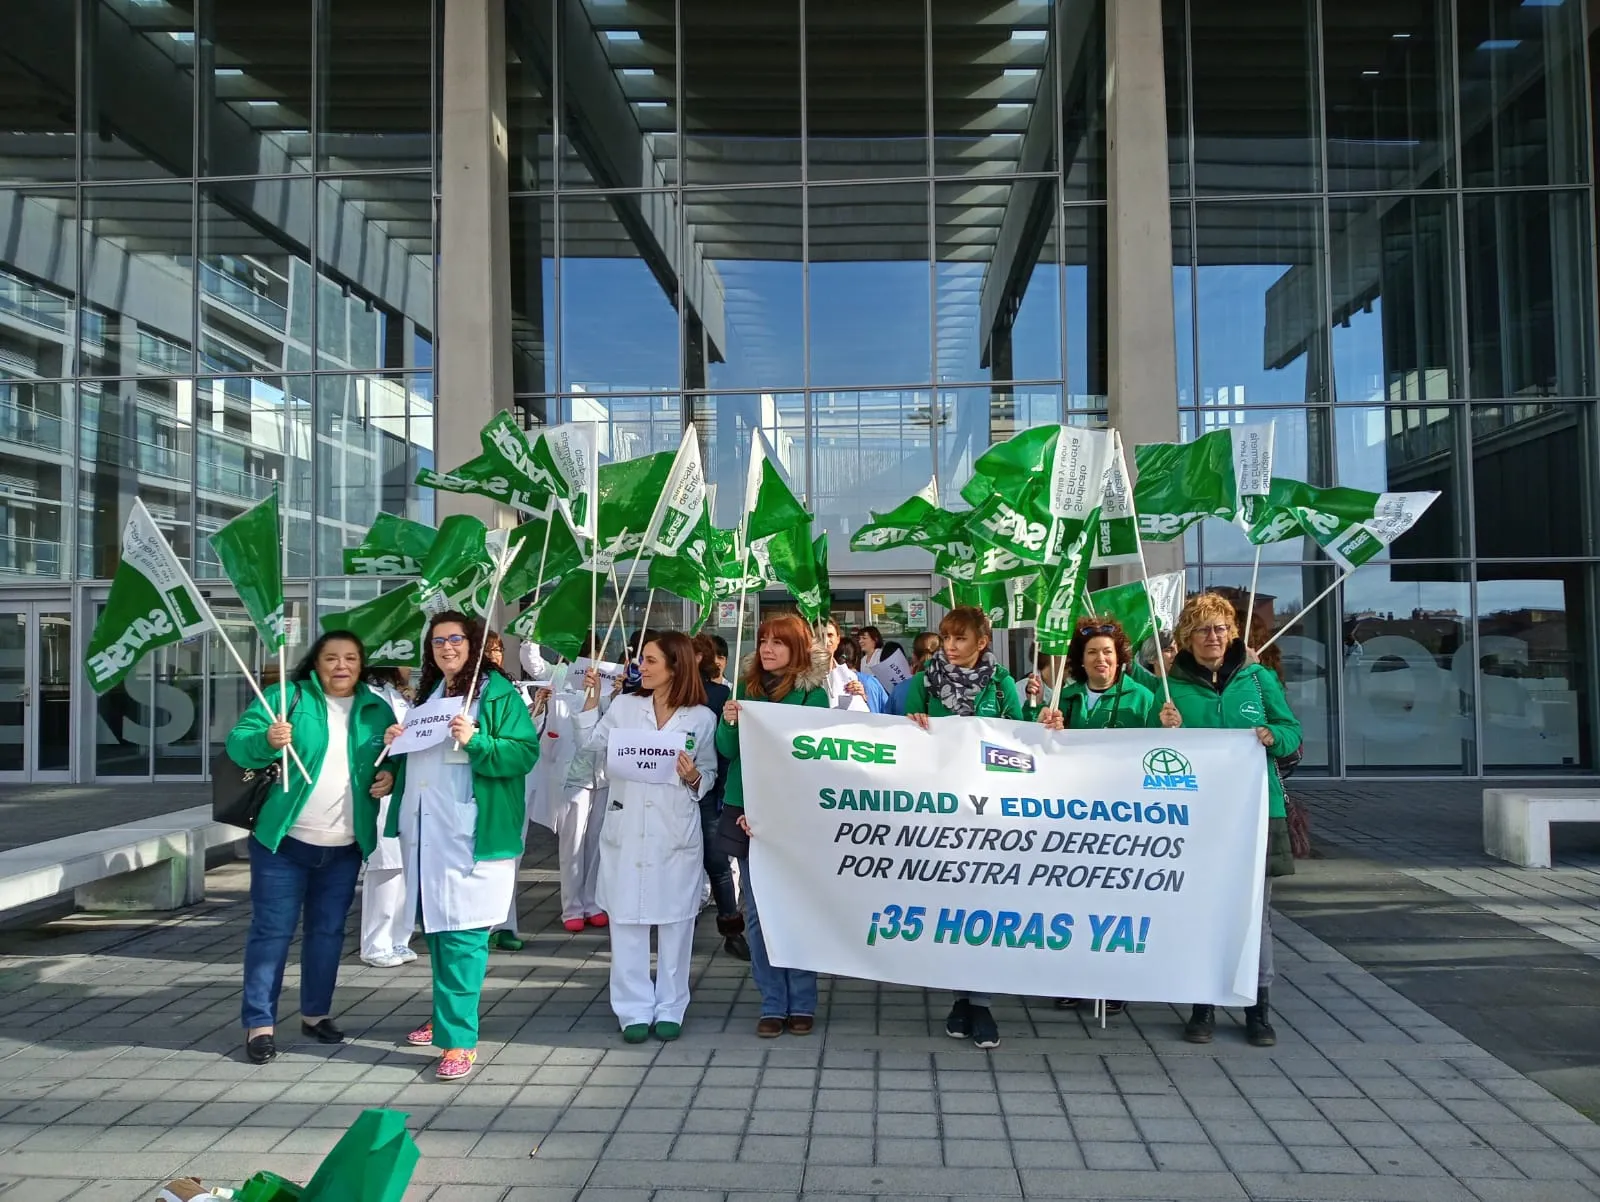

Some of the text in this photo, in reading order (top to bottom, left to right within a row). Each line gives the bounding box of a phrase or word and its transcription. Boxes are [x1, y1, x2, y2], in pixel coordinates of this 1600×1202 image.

[351, 555, 421, 575] TSE
[420, 714, 451, 725] HORAS
[415, 729, 433, 738] YA!!
[617, 747, 676, 757] ¡¡35 HORAS
[791, 735, 896, 764] SATSE
[988, 749, 1032, 769] fses
[636, 761, 657, 769] YA!!
[1143, 775, 1198, 788] ANPE
[819, 788, 1189, 826] SANIDAD Y EDUCACIÓN
[834, 822, 1186, 859] POR NUESTROS DERECHOS
[837, 855, 1185, 893] POR NUESTRA PROFESIÓN
[866, 904, 1151, 954] ¡35 HORAS YA!
